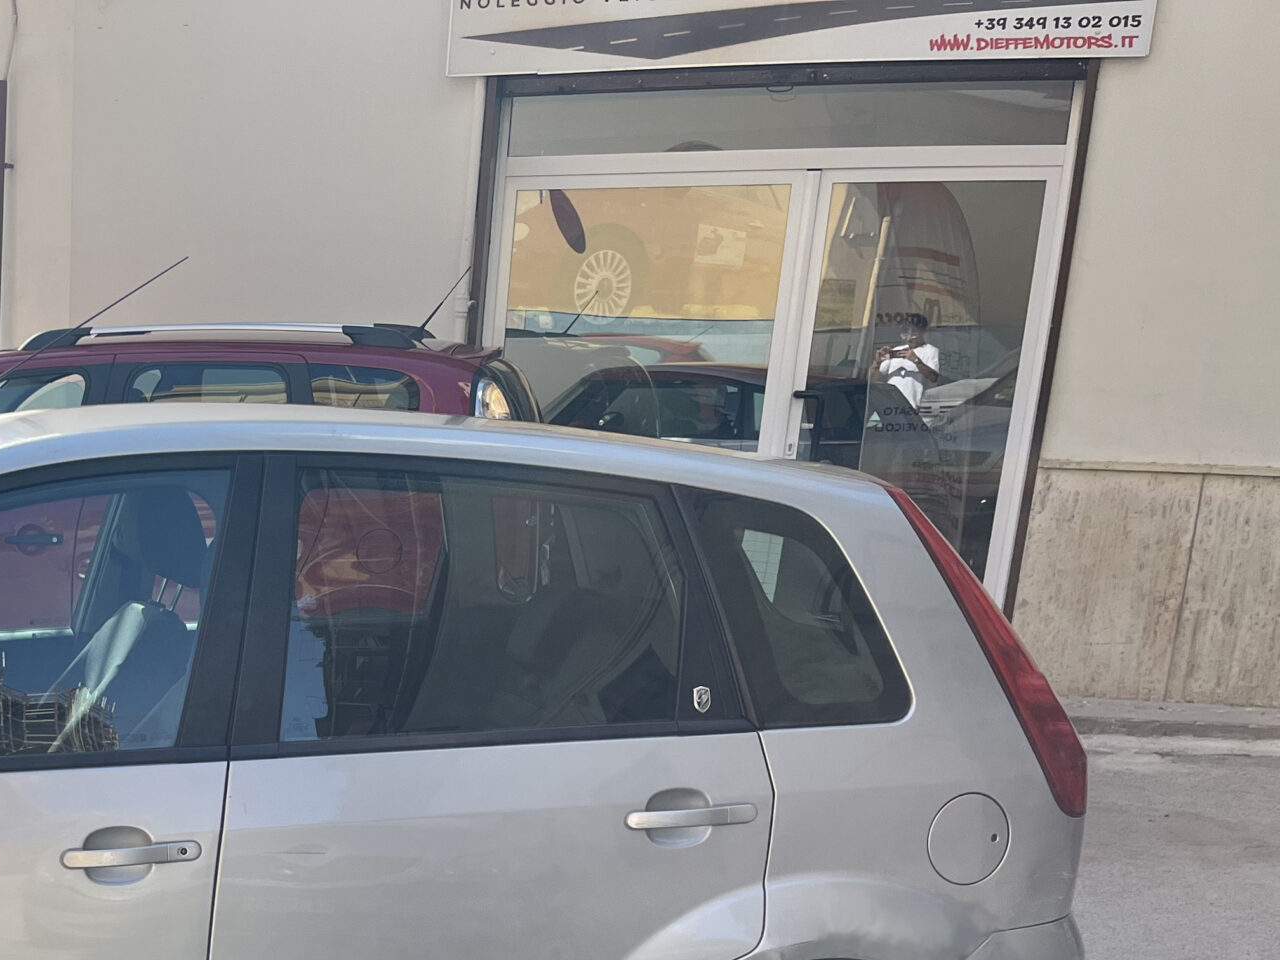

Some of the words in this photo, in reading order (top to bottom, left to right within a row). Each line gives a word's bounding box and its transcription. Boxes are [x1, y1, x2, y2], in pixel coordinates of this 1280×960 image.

[460, 0, 585, 9] NOLE
[974, 17, 1007, 30] +39
[1013, 16, 1047, 30] 349
[1053, 16, 1072, 29] 13
[1078, 15, 1102, 28] 02
[1108, 15, 1142, 28] 015
